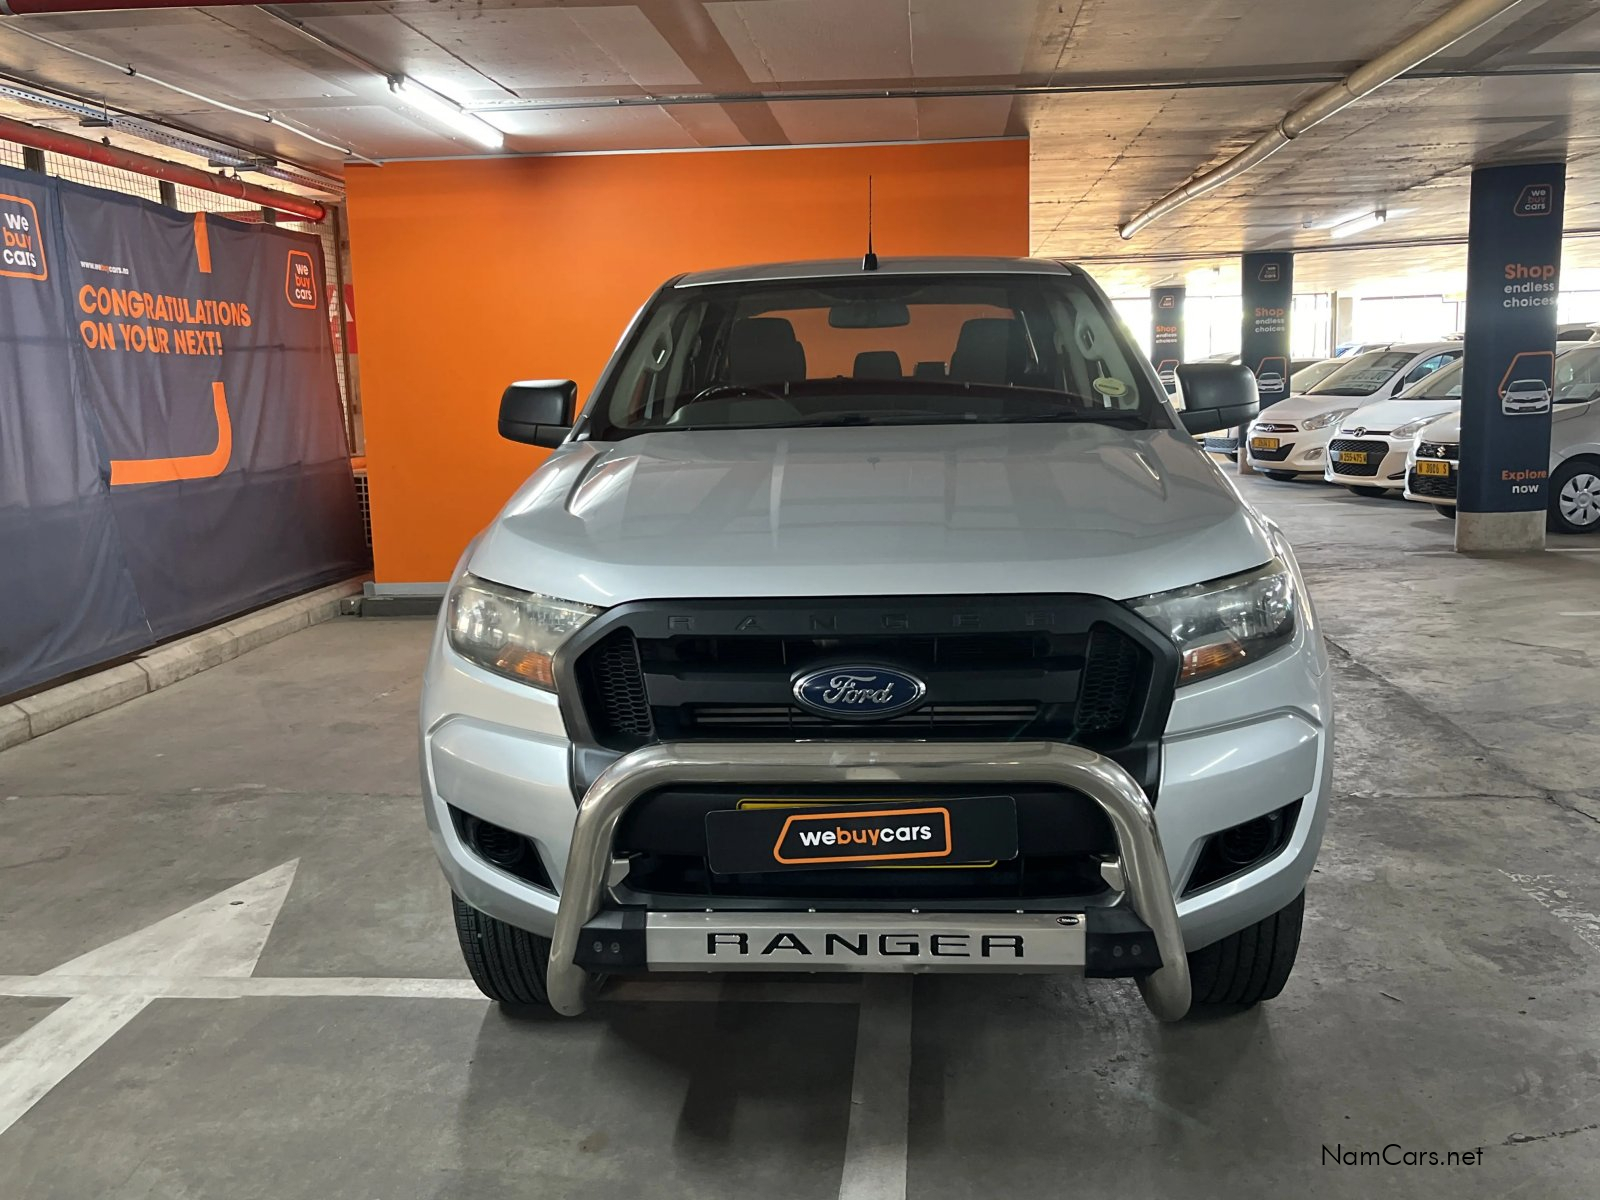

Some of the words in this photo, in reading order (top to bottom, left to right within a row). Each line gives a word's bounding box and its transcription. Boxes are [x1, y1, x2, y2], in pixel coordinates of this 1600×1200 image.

[1531, 189, 1546, 197] we
[1524, 203, 1546, 211] cars
[4, 212, 29, 232] we
[2, 226, 32, 251] buy
[3, 249, 37, 268] cars
[295, 263, 309, 276] we
[1504, 263, 1555, 280] Shop
[294, 273, 311, 290] buy
[1503, 282, 1555, 294] endless
[295, 288, 313, 301] cars
[1502, 296, 1557, 308] choices
[79, 284, 252, 328] CONGRATULATIONS
[1255, 307, 1285, 317] Shop
[1255, 317, 1285, 325] endless
[80, 320, 117, 351] ON
[119, 323, 170, 354] YOUR
[173, 328, 224, 356] NEXT!
[1501, 469, 1548, 481] Explore
[1512, 484, 1539, 494] now
[667, 613, 1056, 632] RANGER
[822, 674, 895, 705] Ford
[799, 825, 932, 847] webuycars
[706, 932, 1025, 958] RANGER
